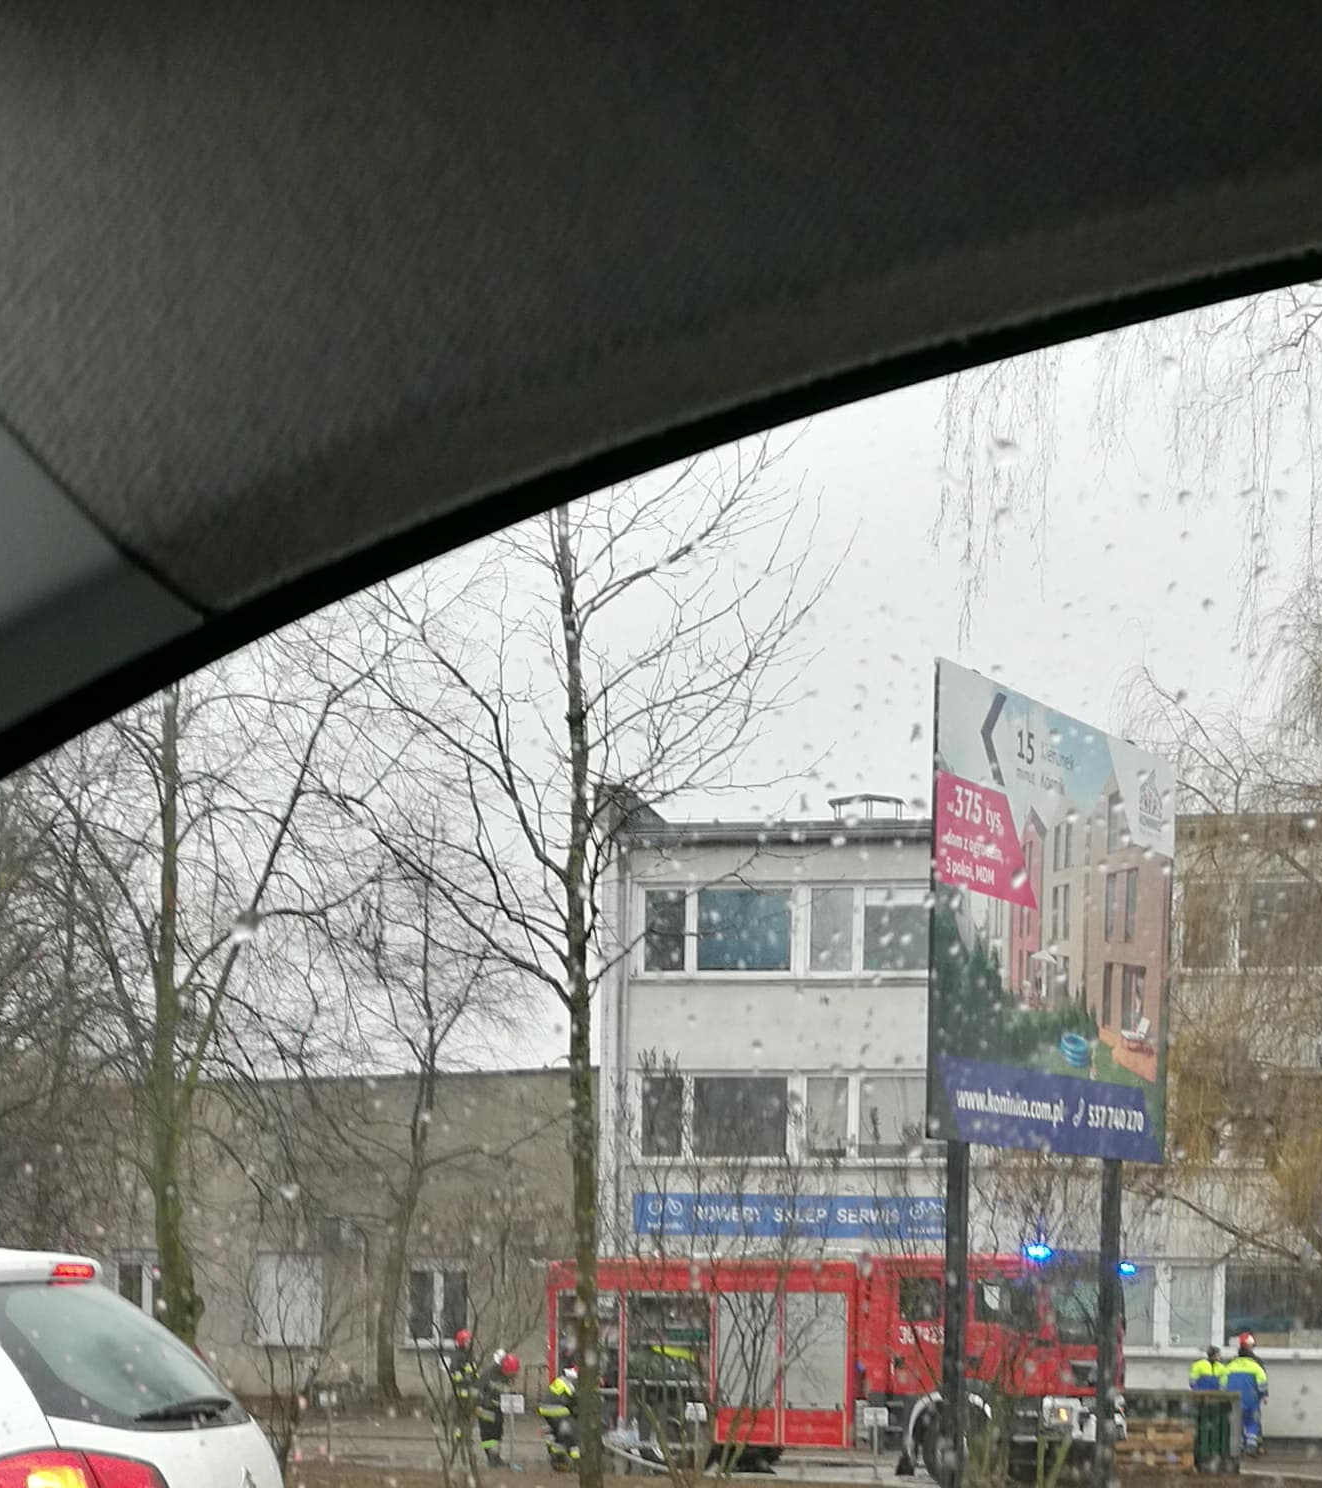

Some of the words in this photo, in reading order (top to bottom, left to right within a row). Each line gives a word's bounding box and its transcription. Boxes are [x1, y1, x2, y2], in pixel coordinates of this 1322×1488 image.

[1017, 729, 1035, 765] 15
[954, 784, 982, 825] 375
[946, 856, 952, 874] 5
[975, 863, 995, 886] MDM
[956, 1087, 1064, 1128] www.koninko.com.pl
[773, 1206, 827, 1224] SKLEP
[836, 1207, 900, 1225] SERWIS
